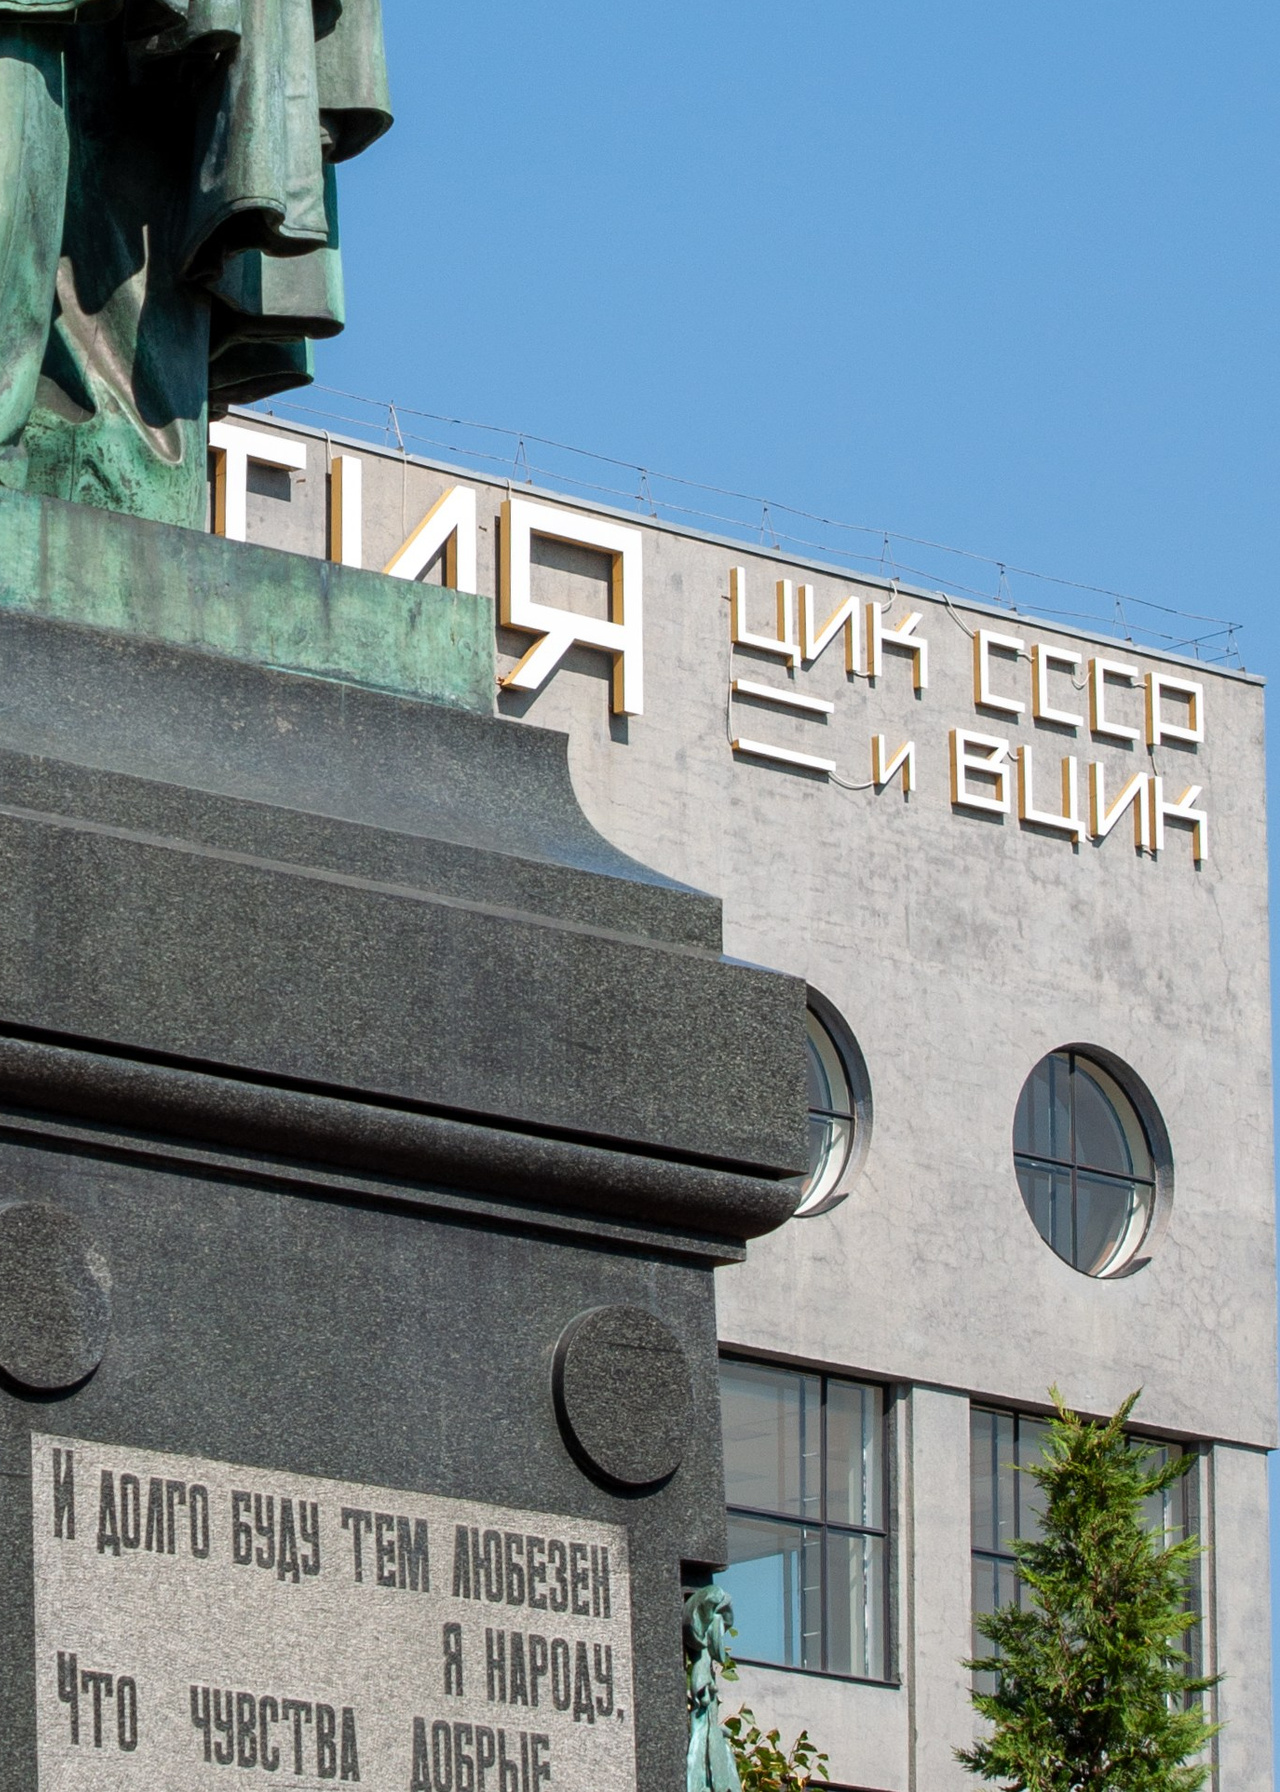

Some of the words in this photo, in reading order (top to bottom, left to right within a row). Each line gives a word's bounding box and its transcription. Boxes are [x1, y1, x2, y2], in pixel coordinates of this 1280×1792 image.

[730, 566, 927, 689] ЦИК
[974, 629, 1204, 746] СССР
[949, 729, 1208, 861] ВЦИК
[53, 1448, 75, 1540] И
[97, 1469, 209, 1559] ДОЛГО
[231, 1489, 320, 1584] БУДУ
[341, 1507, 429, 1592] ТЕМ
[452, 1524, 611, 1619] ЛЮБЕЗЕН
[57, 1651, 138, 1752] ЧТО
[190, 1685, 360, 1782] ЧУВСТВА
[410, 1716, 550, 1792] ДОБРЫЕ
[443, 1622, 463, 1697] Я
[485, 1626, 624, 1725] НАРОДУ,
